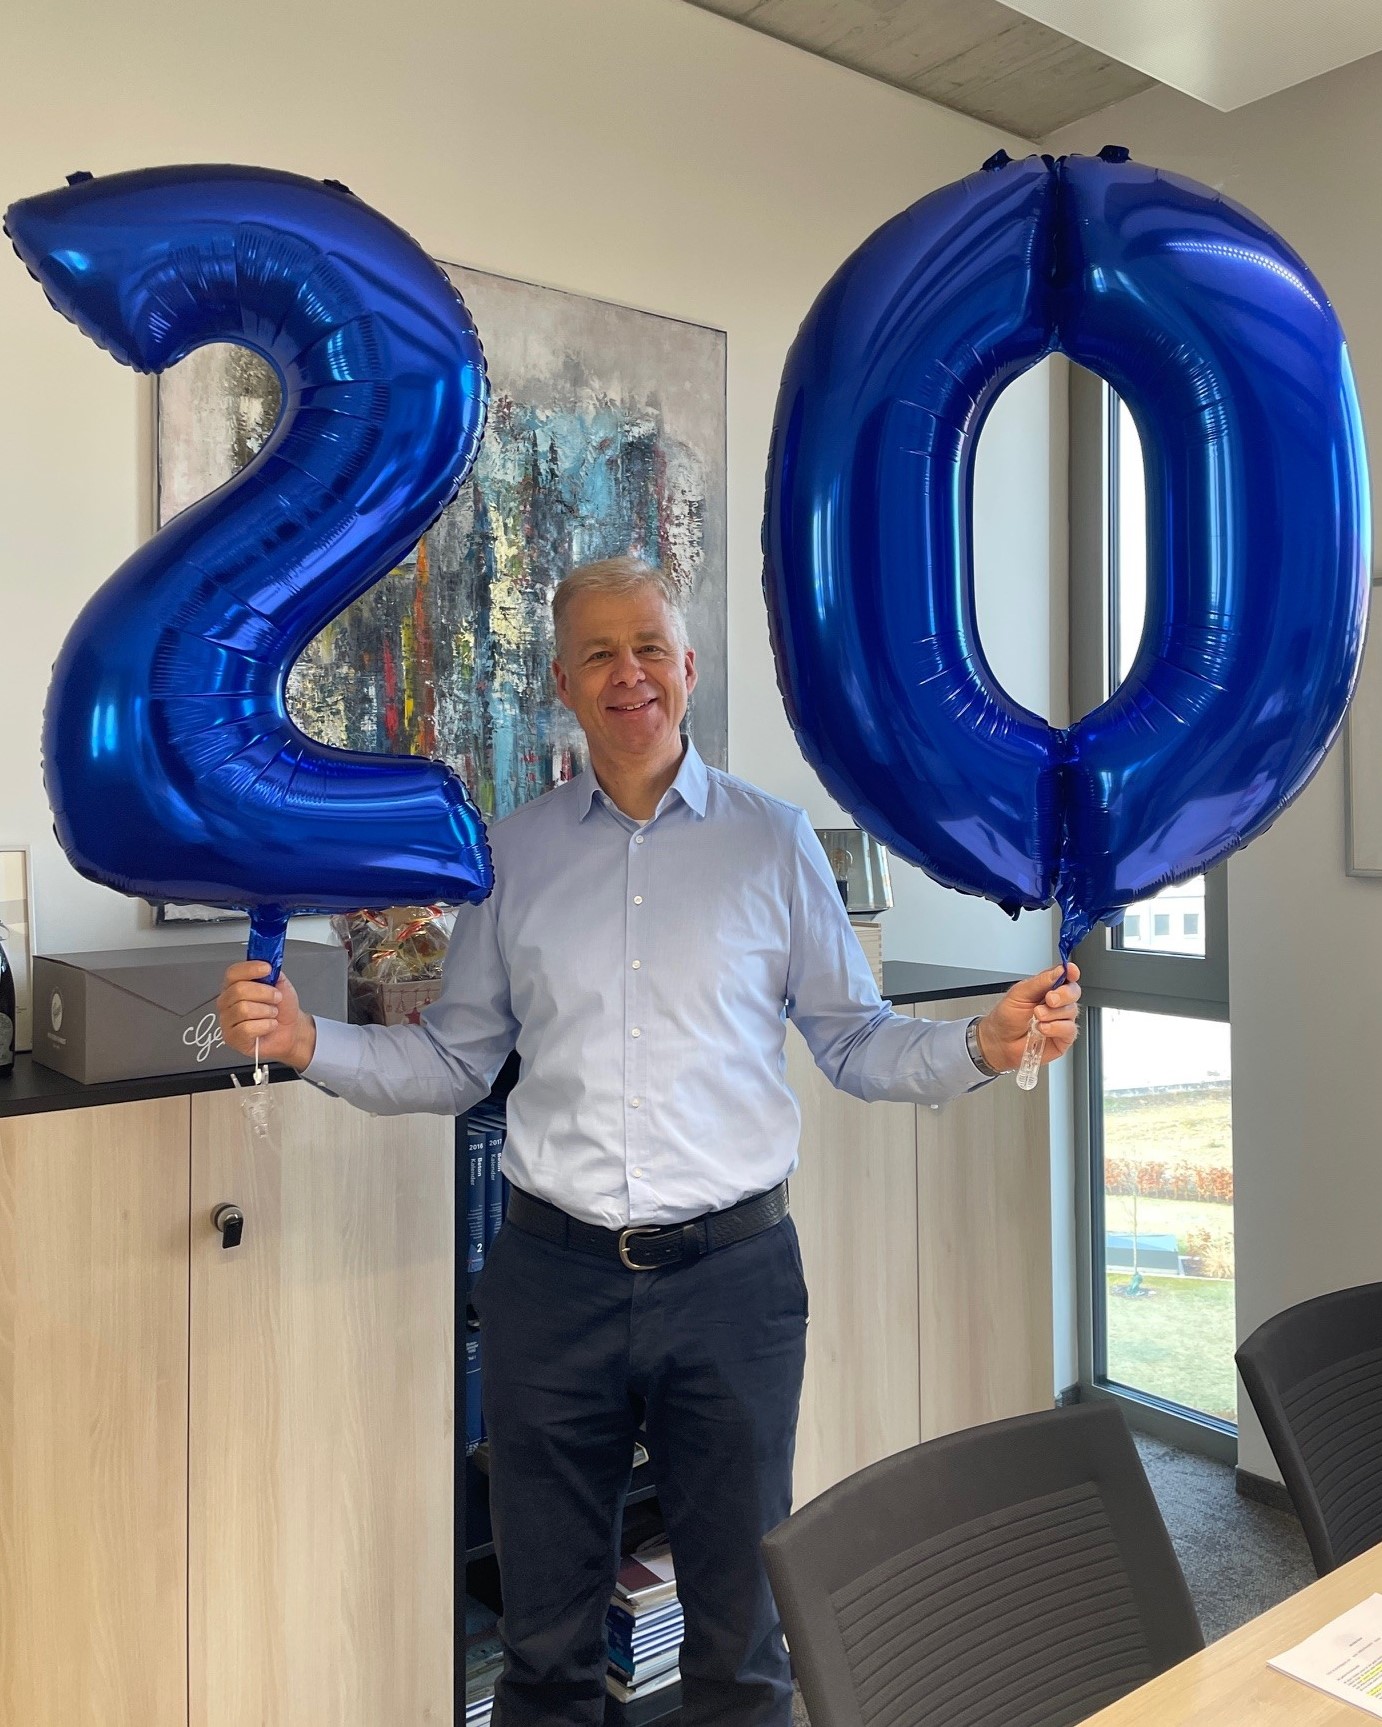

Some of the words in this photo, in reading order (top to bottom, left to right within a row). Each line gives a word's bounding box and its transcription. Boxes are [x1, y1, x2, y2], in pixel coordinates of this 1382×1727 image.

[469, 1142, 484, 1151] 2016
[489, 1138, 502, 1146] 2017
[476, 1243, 483, 1253] 2
